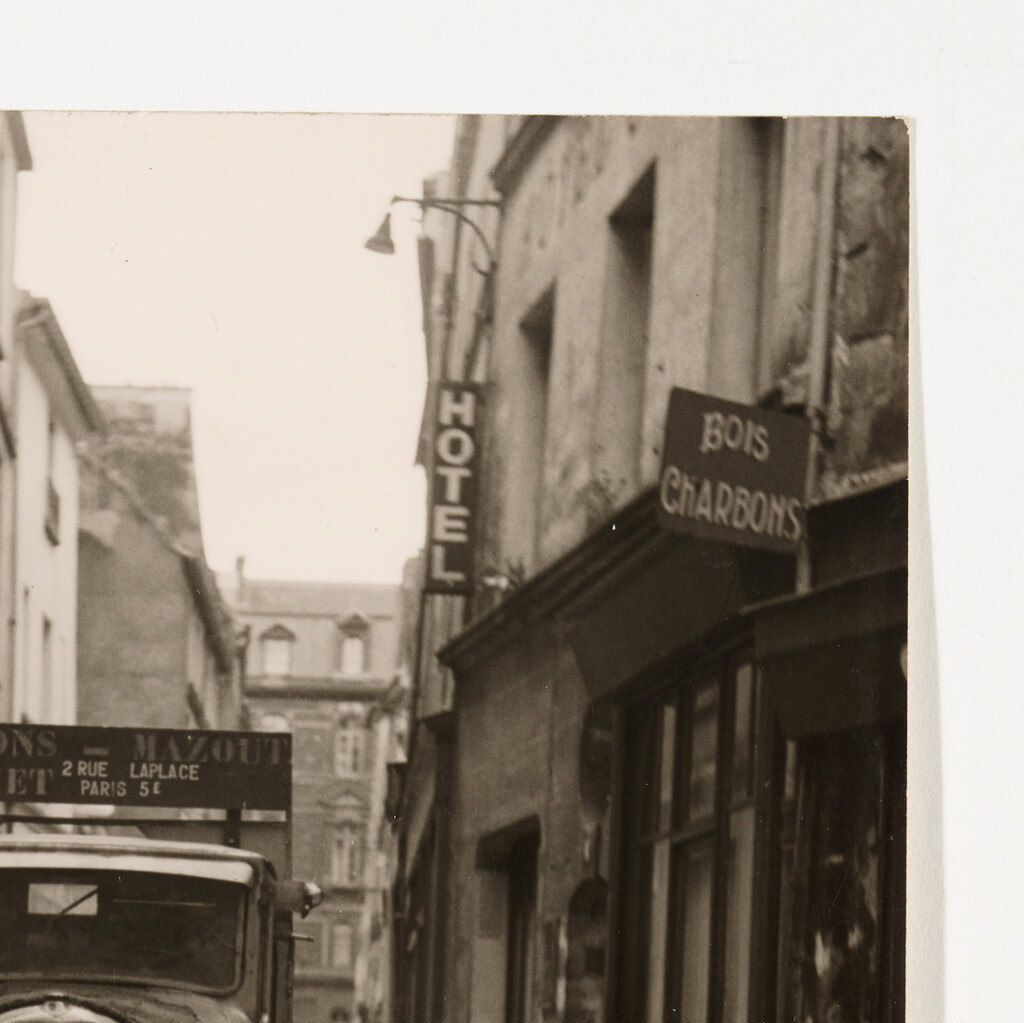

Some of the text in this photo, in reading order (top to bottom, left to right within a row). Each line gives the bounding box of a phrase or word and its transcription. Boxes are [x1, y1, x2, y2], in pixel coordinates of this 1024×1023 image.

[701, 411, 770, 462] BOIS
[431, 390, 475, 582] HOTEL
[133, 734, 290, 766] MAZOUT
[61, 760, 200, 781] 2 RUE LAPLACE
[80, 780, 127, 797] PARIS
